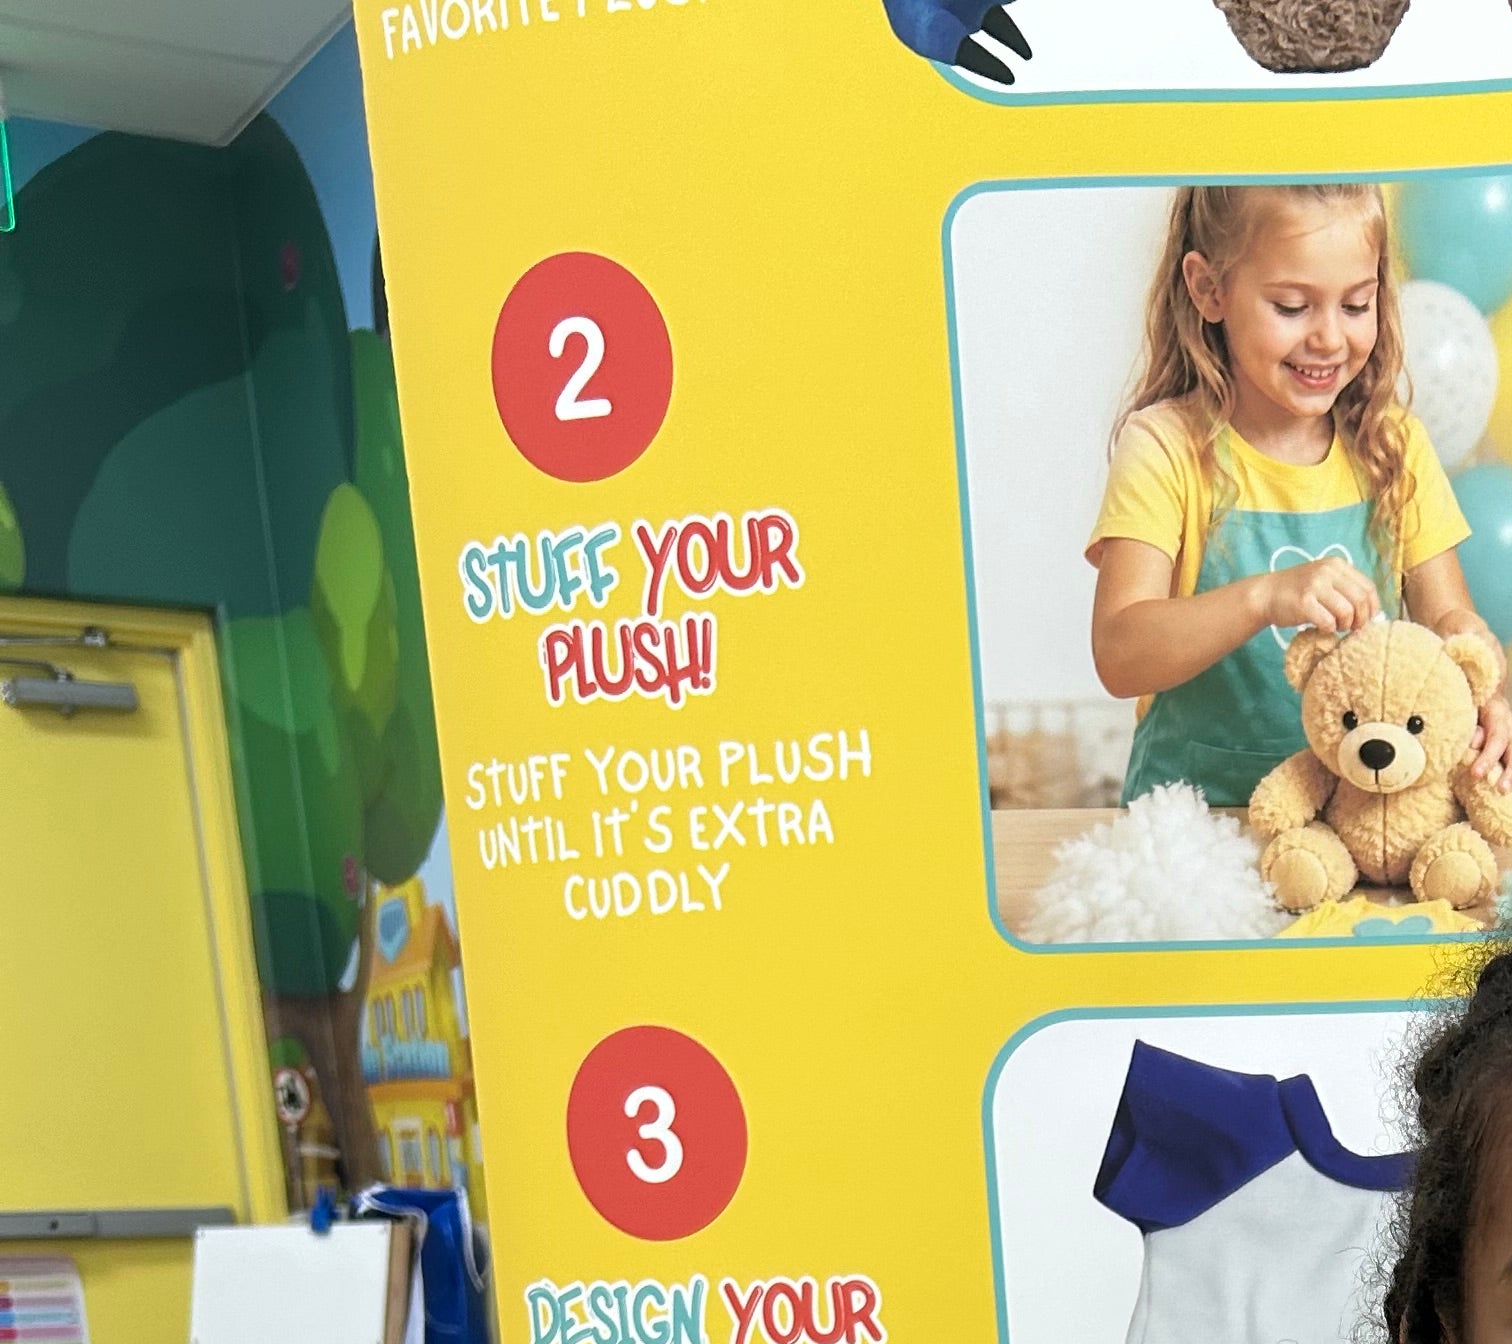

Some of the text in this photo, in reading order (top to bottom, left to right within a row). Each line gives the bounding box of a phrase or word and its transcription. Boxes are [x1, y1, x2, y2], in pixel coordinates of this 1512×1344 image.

[547, 315, 613, 422] 2
[463, 514, 800, 618] STUFF YOUR
[543, 617, 712, 704] PLUSH!
[465, 728, 872, 810] STUFF YOUR PLUSH
[479, 798, 835, 871] UNTIL IT'S EXTRA
[563, 862, 730, 920] CUDDLY
[623, 1084, 684, 1184] 3
